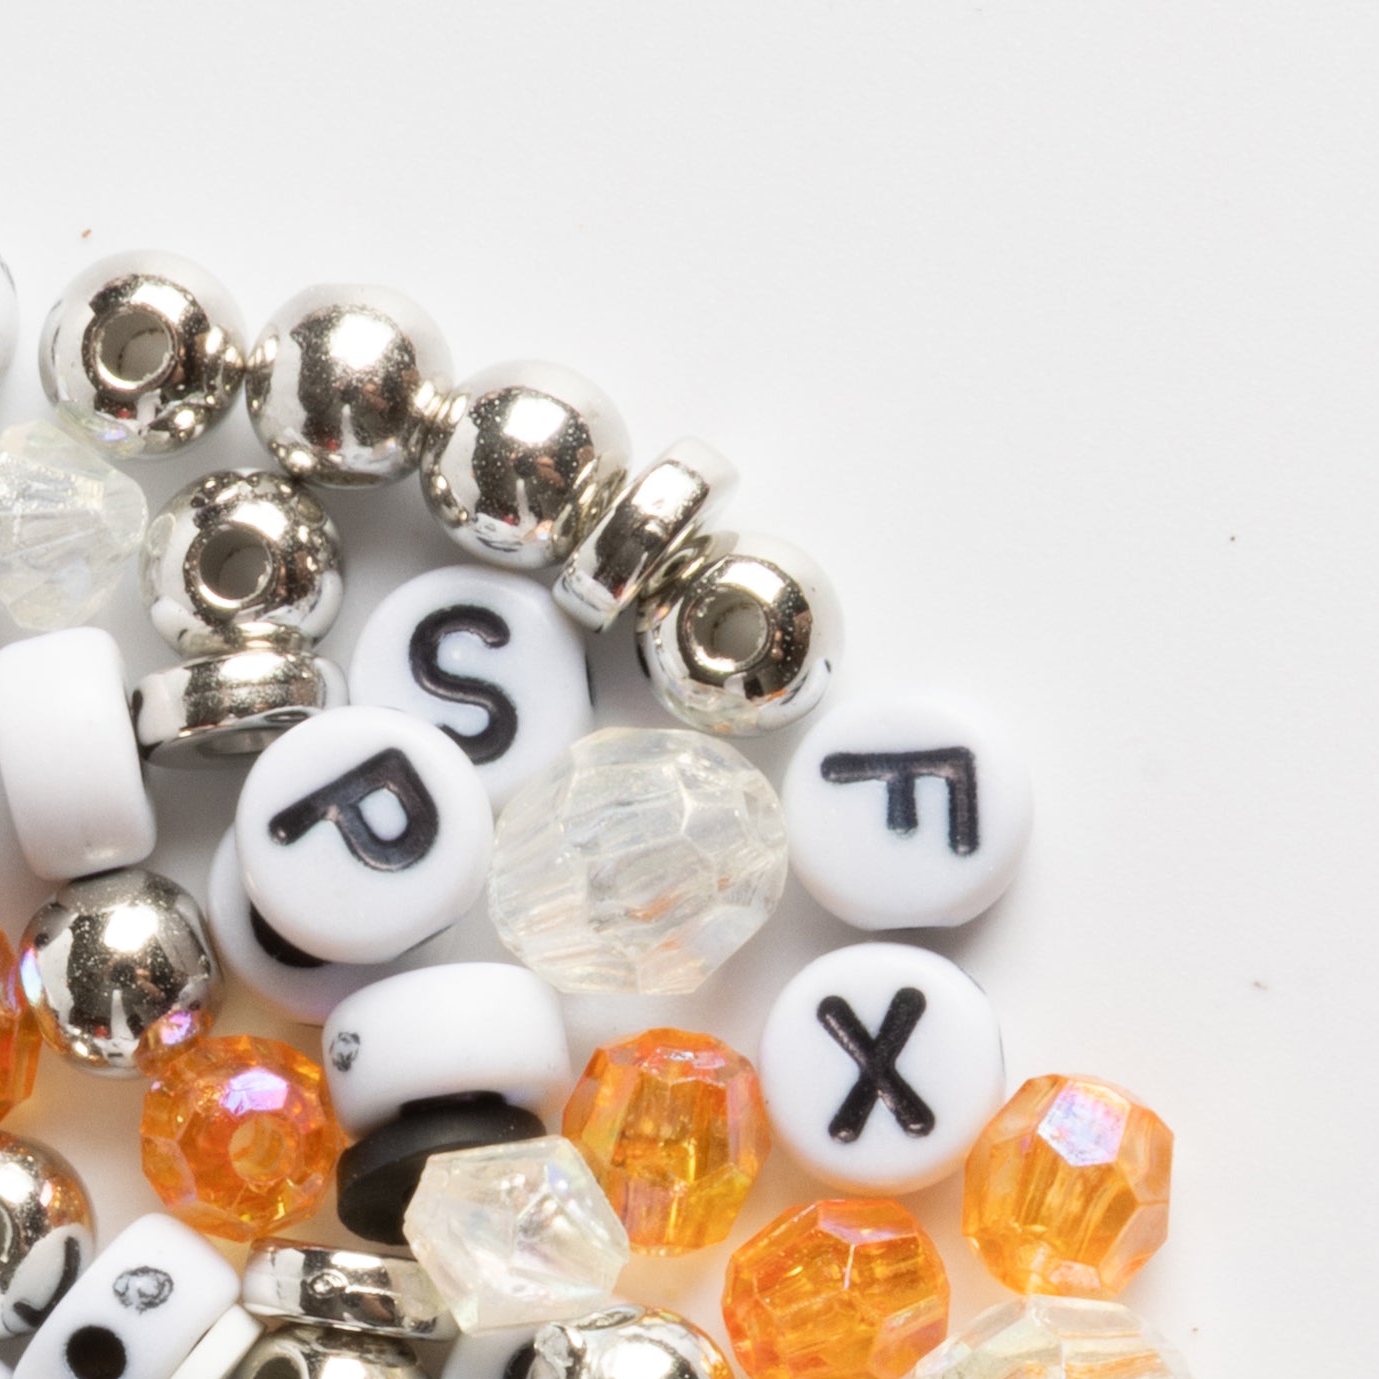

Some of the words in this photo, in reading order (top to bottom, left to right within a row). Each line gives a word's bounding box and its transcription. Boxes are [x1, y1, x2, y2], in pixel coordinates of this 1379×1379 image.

[409, 604, 518, 764] S
[268, 748, 439, 870] P
[820, 747, 980, 855] F
[816, 987, 936, 1144] X
